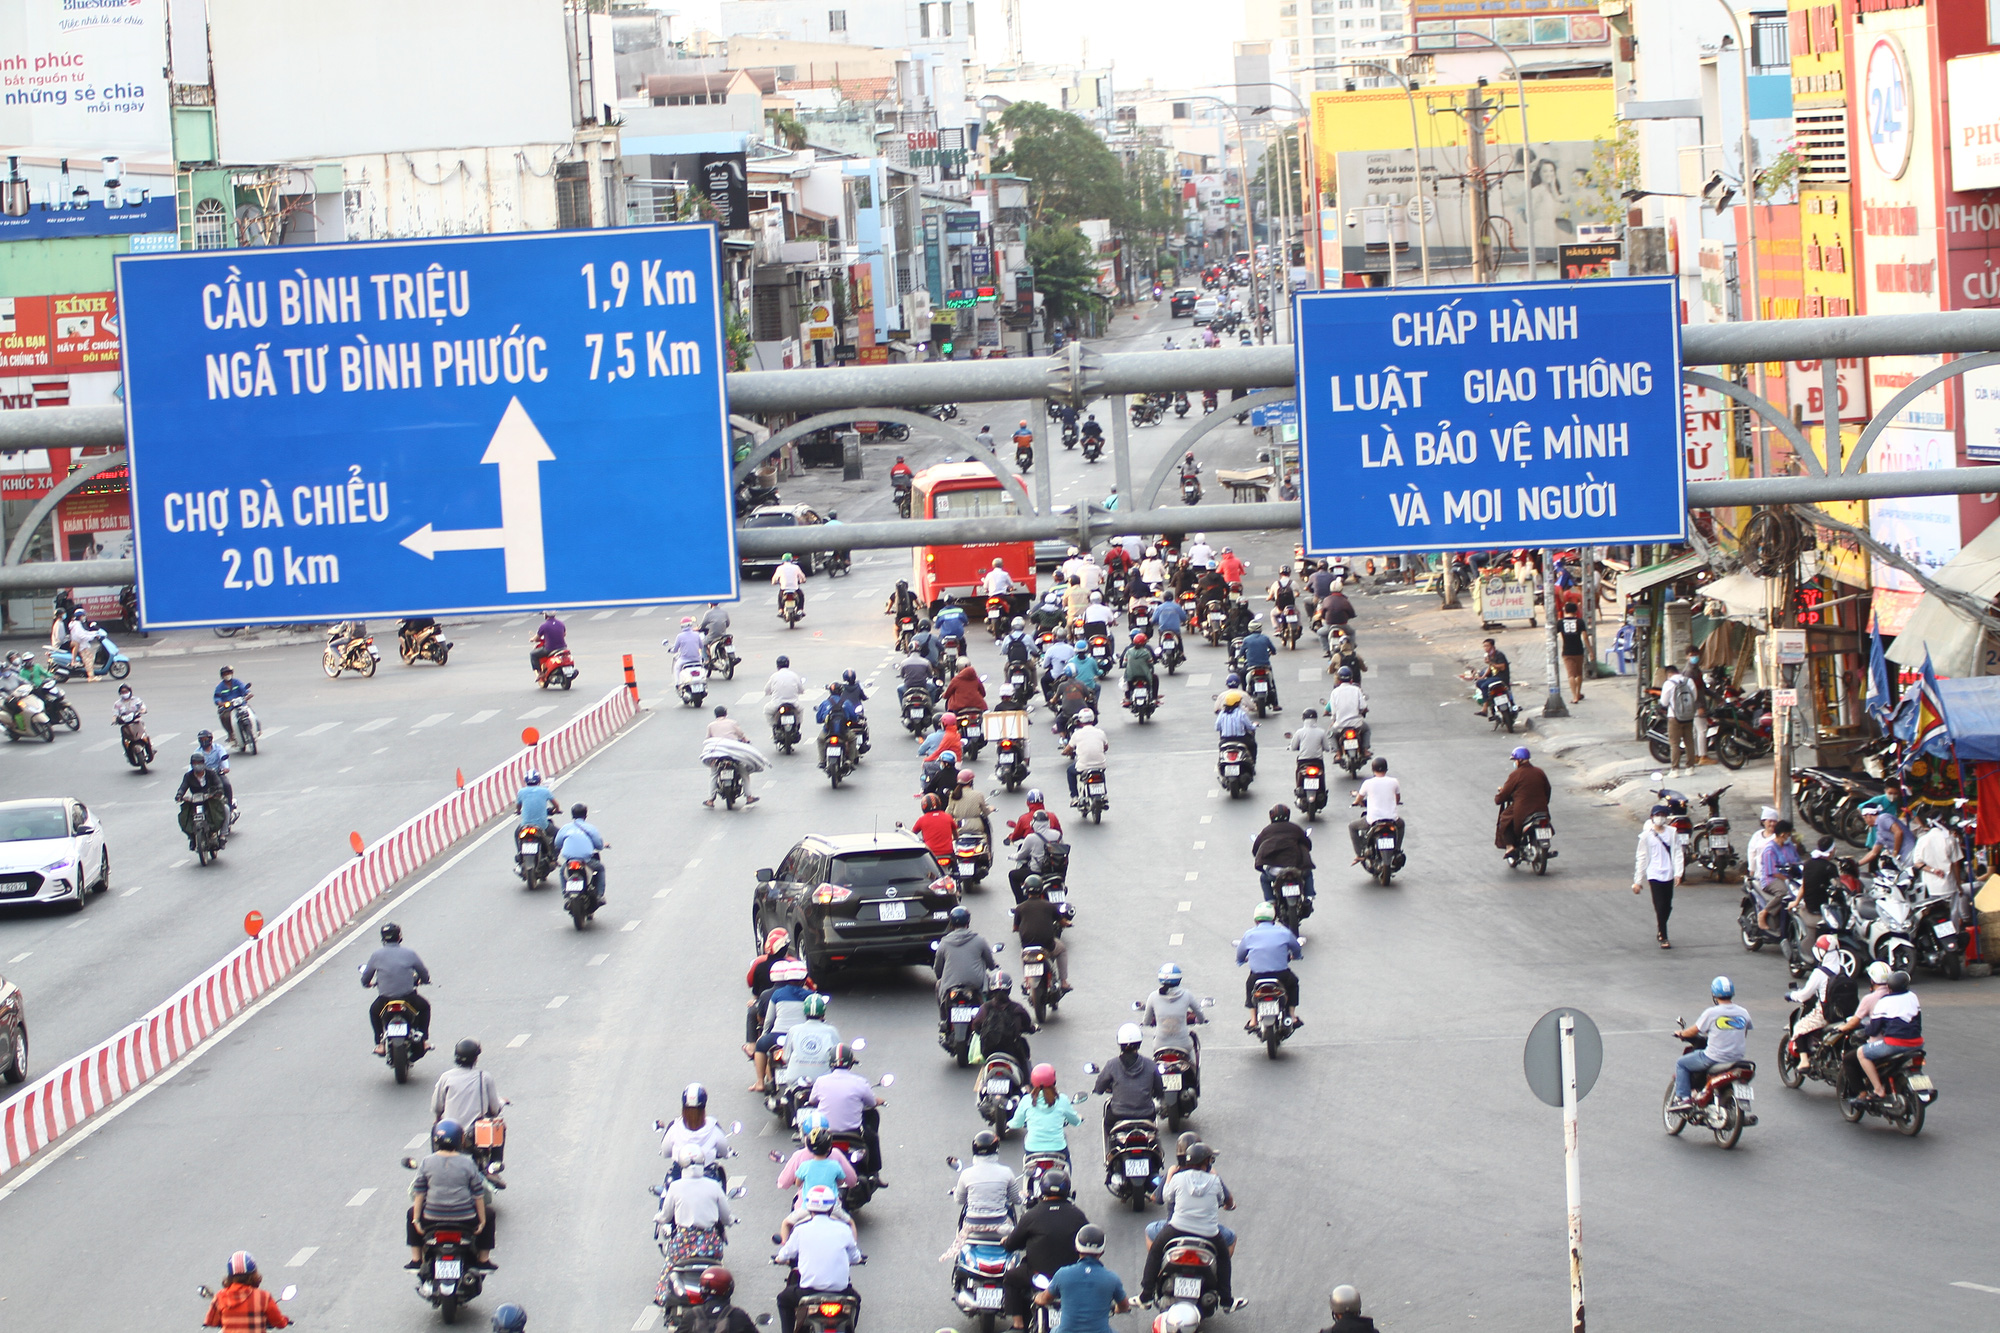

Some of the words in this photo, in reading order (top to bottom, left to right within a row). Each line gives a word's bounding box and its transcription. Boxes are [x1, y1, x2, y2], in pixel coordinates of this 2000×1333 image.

[63, 0, 127, 11] BlueStone
[34, 51, 84, 72] phúc
[5, 88, 67, 105] những
[74, 83, 96, 101] sẻ
[103, 82, 145, 99] chia
[115, 101, 145, 114] ngày
[134, 236, 175, 244] PACIFIC
[1566, 246, 1590, 256] HÀNG
[1592, 245, 1616, 256] VÀNG
[1963, 258, 2000, 301] CỬ
[202, 265, 268, 330] CẦU
[279, 268, 362, 326] BÌNH
[370, 262, 470, 326] TRIỆU
[581, 261, 630, 313] 1,9
[641, 259, 697, 307] Km
[55, 296, 108, 315] KÍNH
[1391, 298, 1477, 347] CHẤP
[1490, 299, 1578, 343] HÀNH
[5, 333, 24, 350] CỦA
[26, 335, 46, 350] BẠN
[9, 352, 35, 367] CHÚNG
[36, 350, 48, 365] TÔI
[83, 351, 99, 362] ĐÔI
[206, 342, 278, 400] NGÃ
[283, 344, 329, 394] TƯ
[340, 334, 423, 392] BÌNH
[432, 323, 549, 388] PHƯỚC
[585, 332, 636, 384] 7,5
[646, 330, 701, 378] Km
[1331, 365, 1428, 416] LUẬT
[1464, 367, 1537, 404] GIAO
[1546, 357, 1653, 400] THÔNG
[1361, 424, 1404, 468] LÀ
[1415, 420, 1478, 466] BẢO
[1490, 421, 1533, 468] VỆ
[1544, 414, 1629, 460] MÌNH
[3, 476, 34, 491] KHÚC
[38, 477, 54, 494] XẠ
[164, 487, 230, 537] CHỢ
[240, 479, 285, 529] BÀ
[292, 464, 389, 527] CHIỂU
[1389, 483, 1431, 527] VÀ
[1443, 488, 1502, 531] MỌI
[1518, 472, 1617, 522] NGƯỜI
[63, 517, 83, 532] KHÁM
[222, 546, 274, 591] 2,0
[283, 546, 340, 586] km
[1506, 596, 1525, 606] PHÊ
